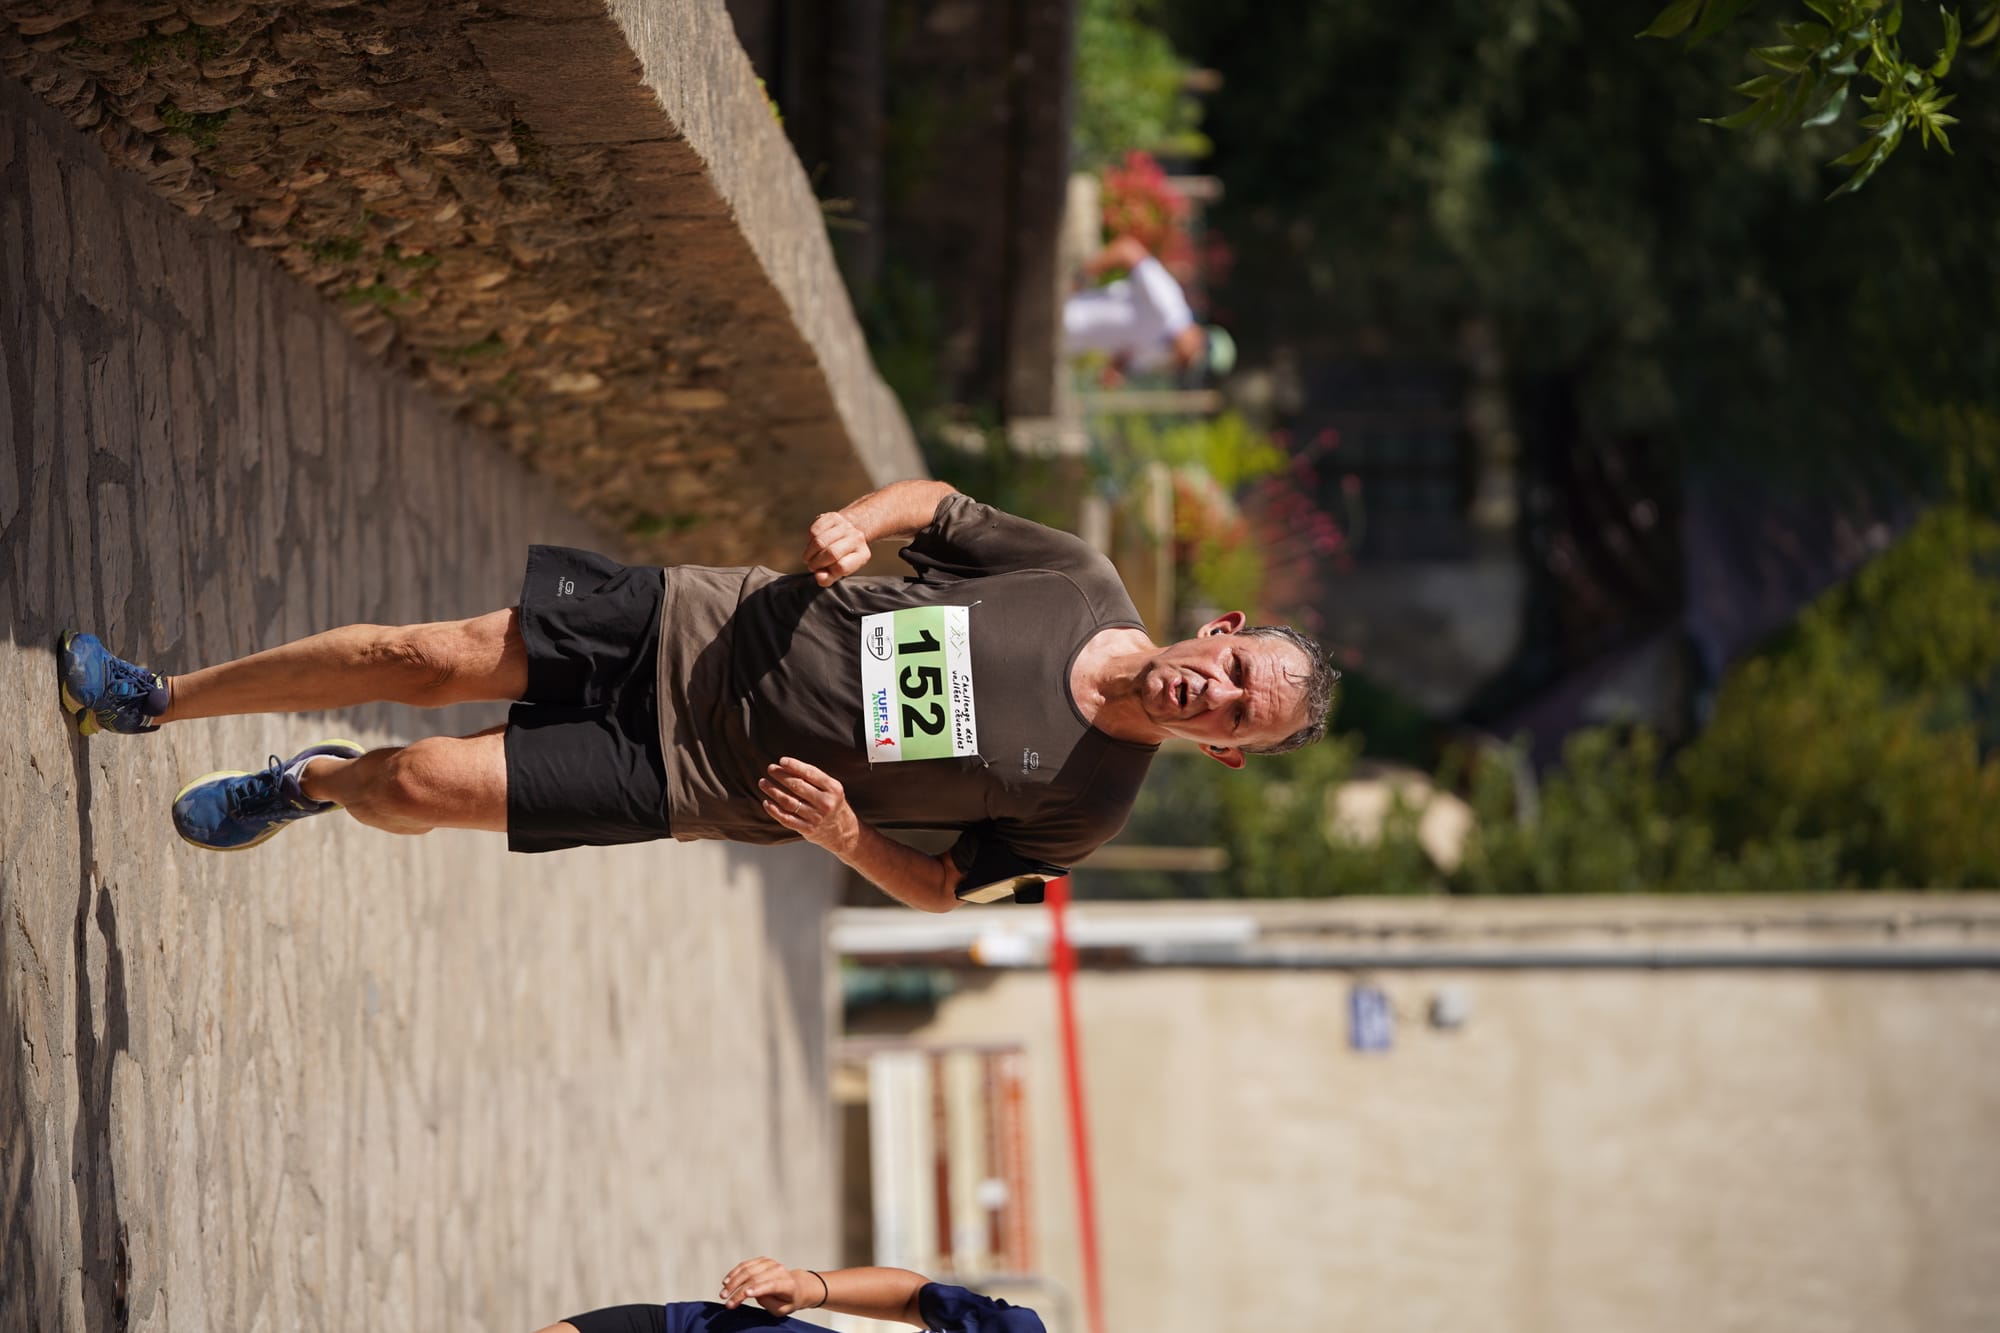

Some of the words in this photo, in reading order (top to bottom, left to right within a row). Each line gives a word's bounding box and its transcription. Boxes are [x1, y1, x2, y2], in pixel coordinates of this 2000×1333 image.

[875, 626, 884, 656] BFP
[898, 629, 946, 738] 152
[952, 670, 961, 703] vallées
[961, 675, 971, 722] Challenge
[872, 693, 881, 738] Aventure
[877, 688, 889, 733] TUFF'S
[955, 709, 964, 750] cévenoles
